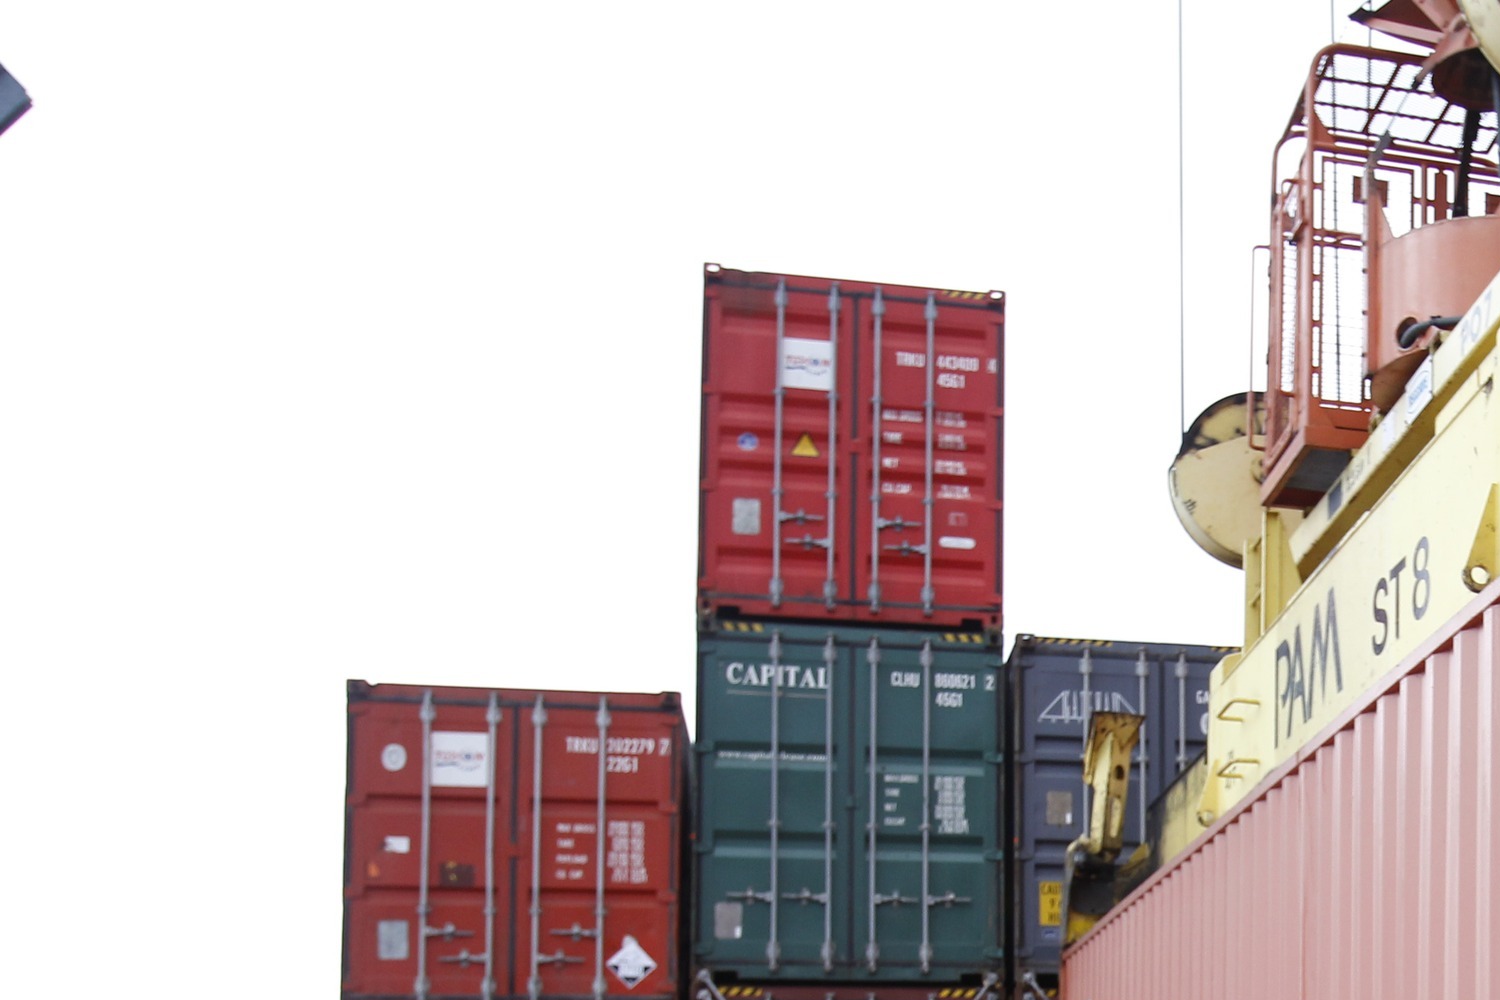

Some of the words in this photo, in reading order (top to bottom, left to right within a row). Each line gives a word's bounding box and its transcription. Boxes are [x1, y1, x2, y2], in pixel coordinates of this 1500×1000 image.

[725, 662, 828, 690] CAPITAL
[1274, 586, 1343, 749] PAM
[984, 675, 995, 691] 2
